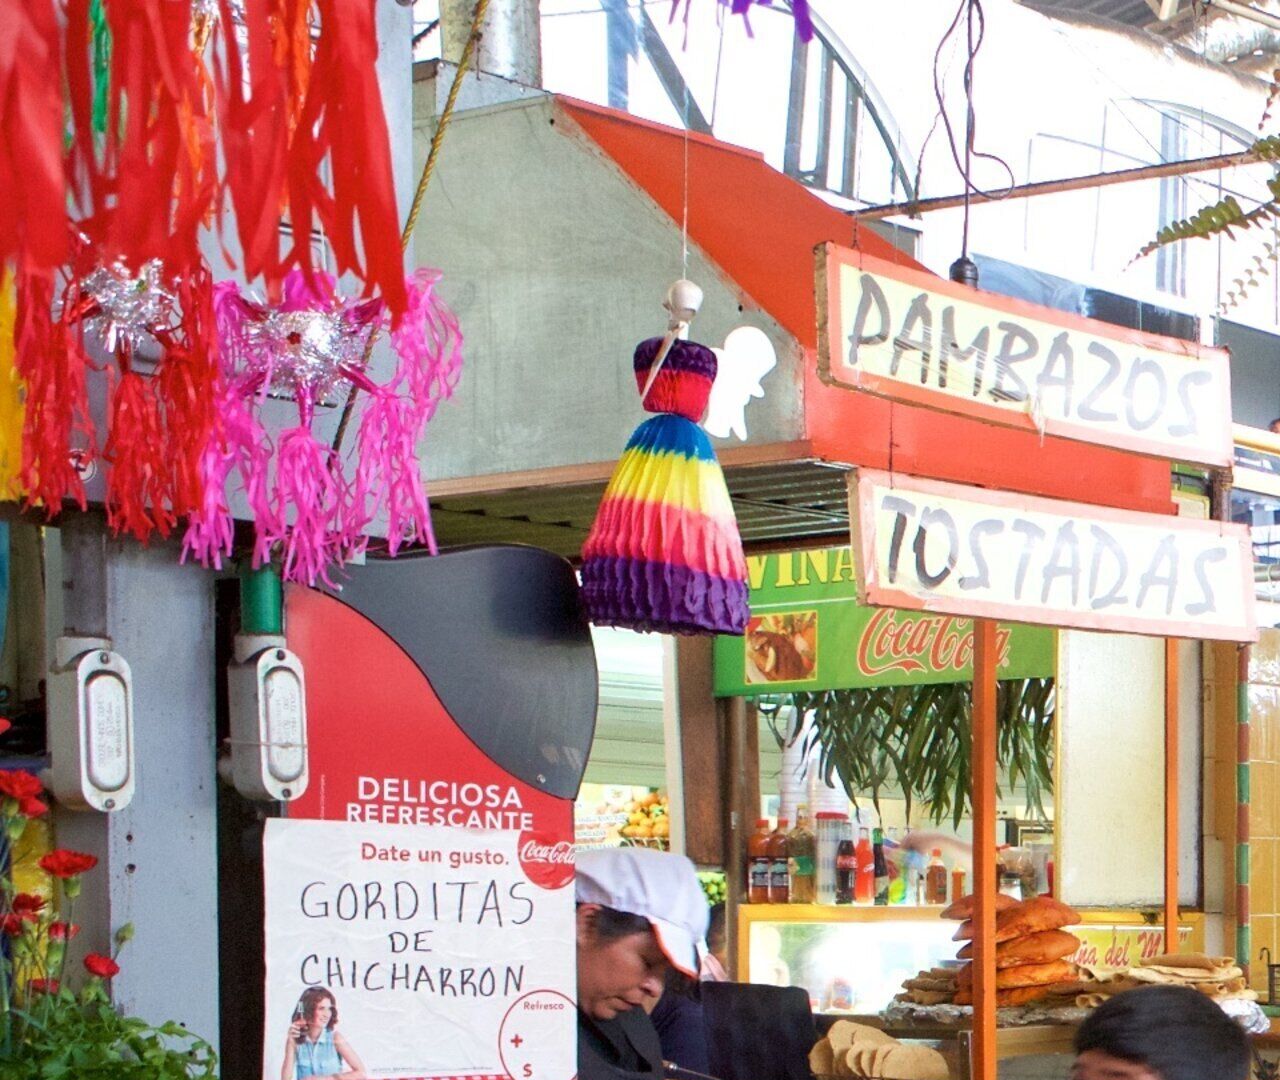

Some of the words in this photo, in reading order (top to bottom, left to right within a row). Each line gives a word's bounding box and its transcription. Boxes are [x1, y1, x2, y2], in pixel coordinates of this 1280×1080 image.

[848, 274, 1213, 437] PAMBAZOS
[881, 496, 1228, 615] TOSTADAS
[857, 607, 1010, 676] Coca-Coa
[358, 776, 523, 809] DELICIOSA
[346, 802, 534, 831] REFRESCANTE
[361, 843, 411, 862] Date
[418, 849, 442, 862] un
[449, 850, 509, 868] gusto.
[520, 840, 576, 864] Coca-Cola
[300, 879, 534, 928] GORDITAS
[388, 930, 434, 953] DE
[1105, 936, 1130, 966] del
[300, 953, 524, 997] CHICHARRON
[523, 1001, 564, 1011] Refresco
